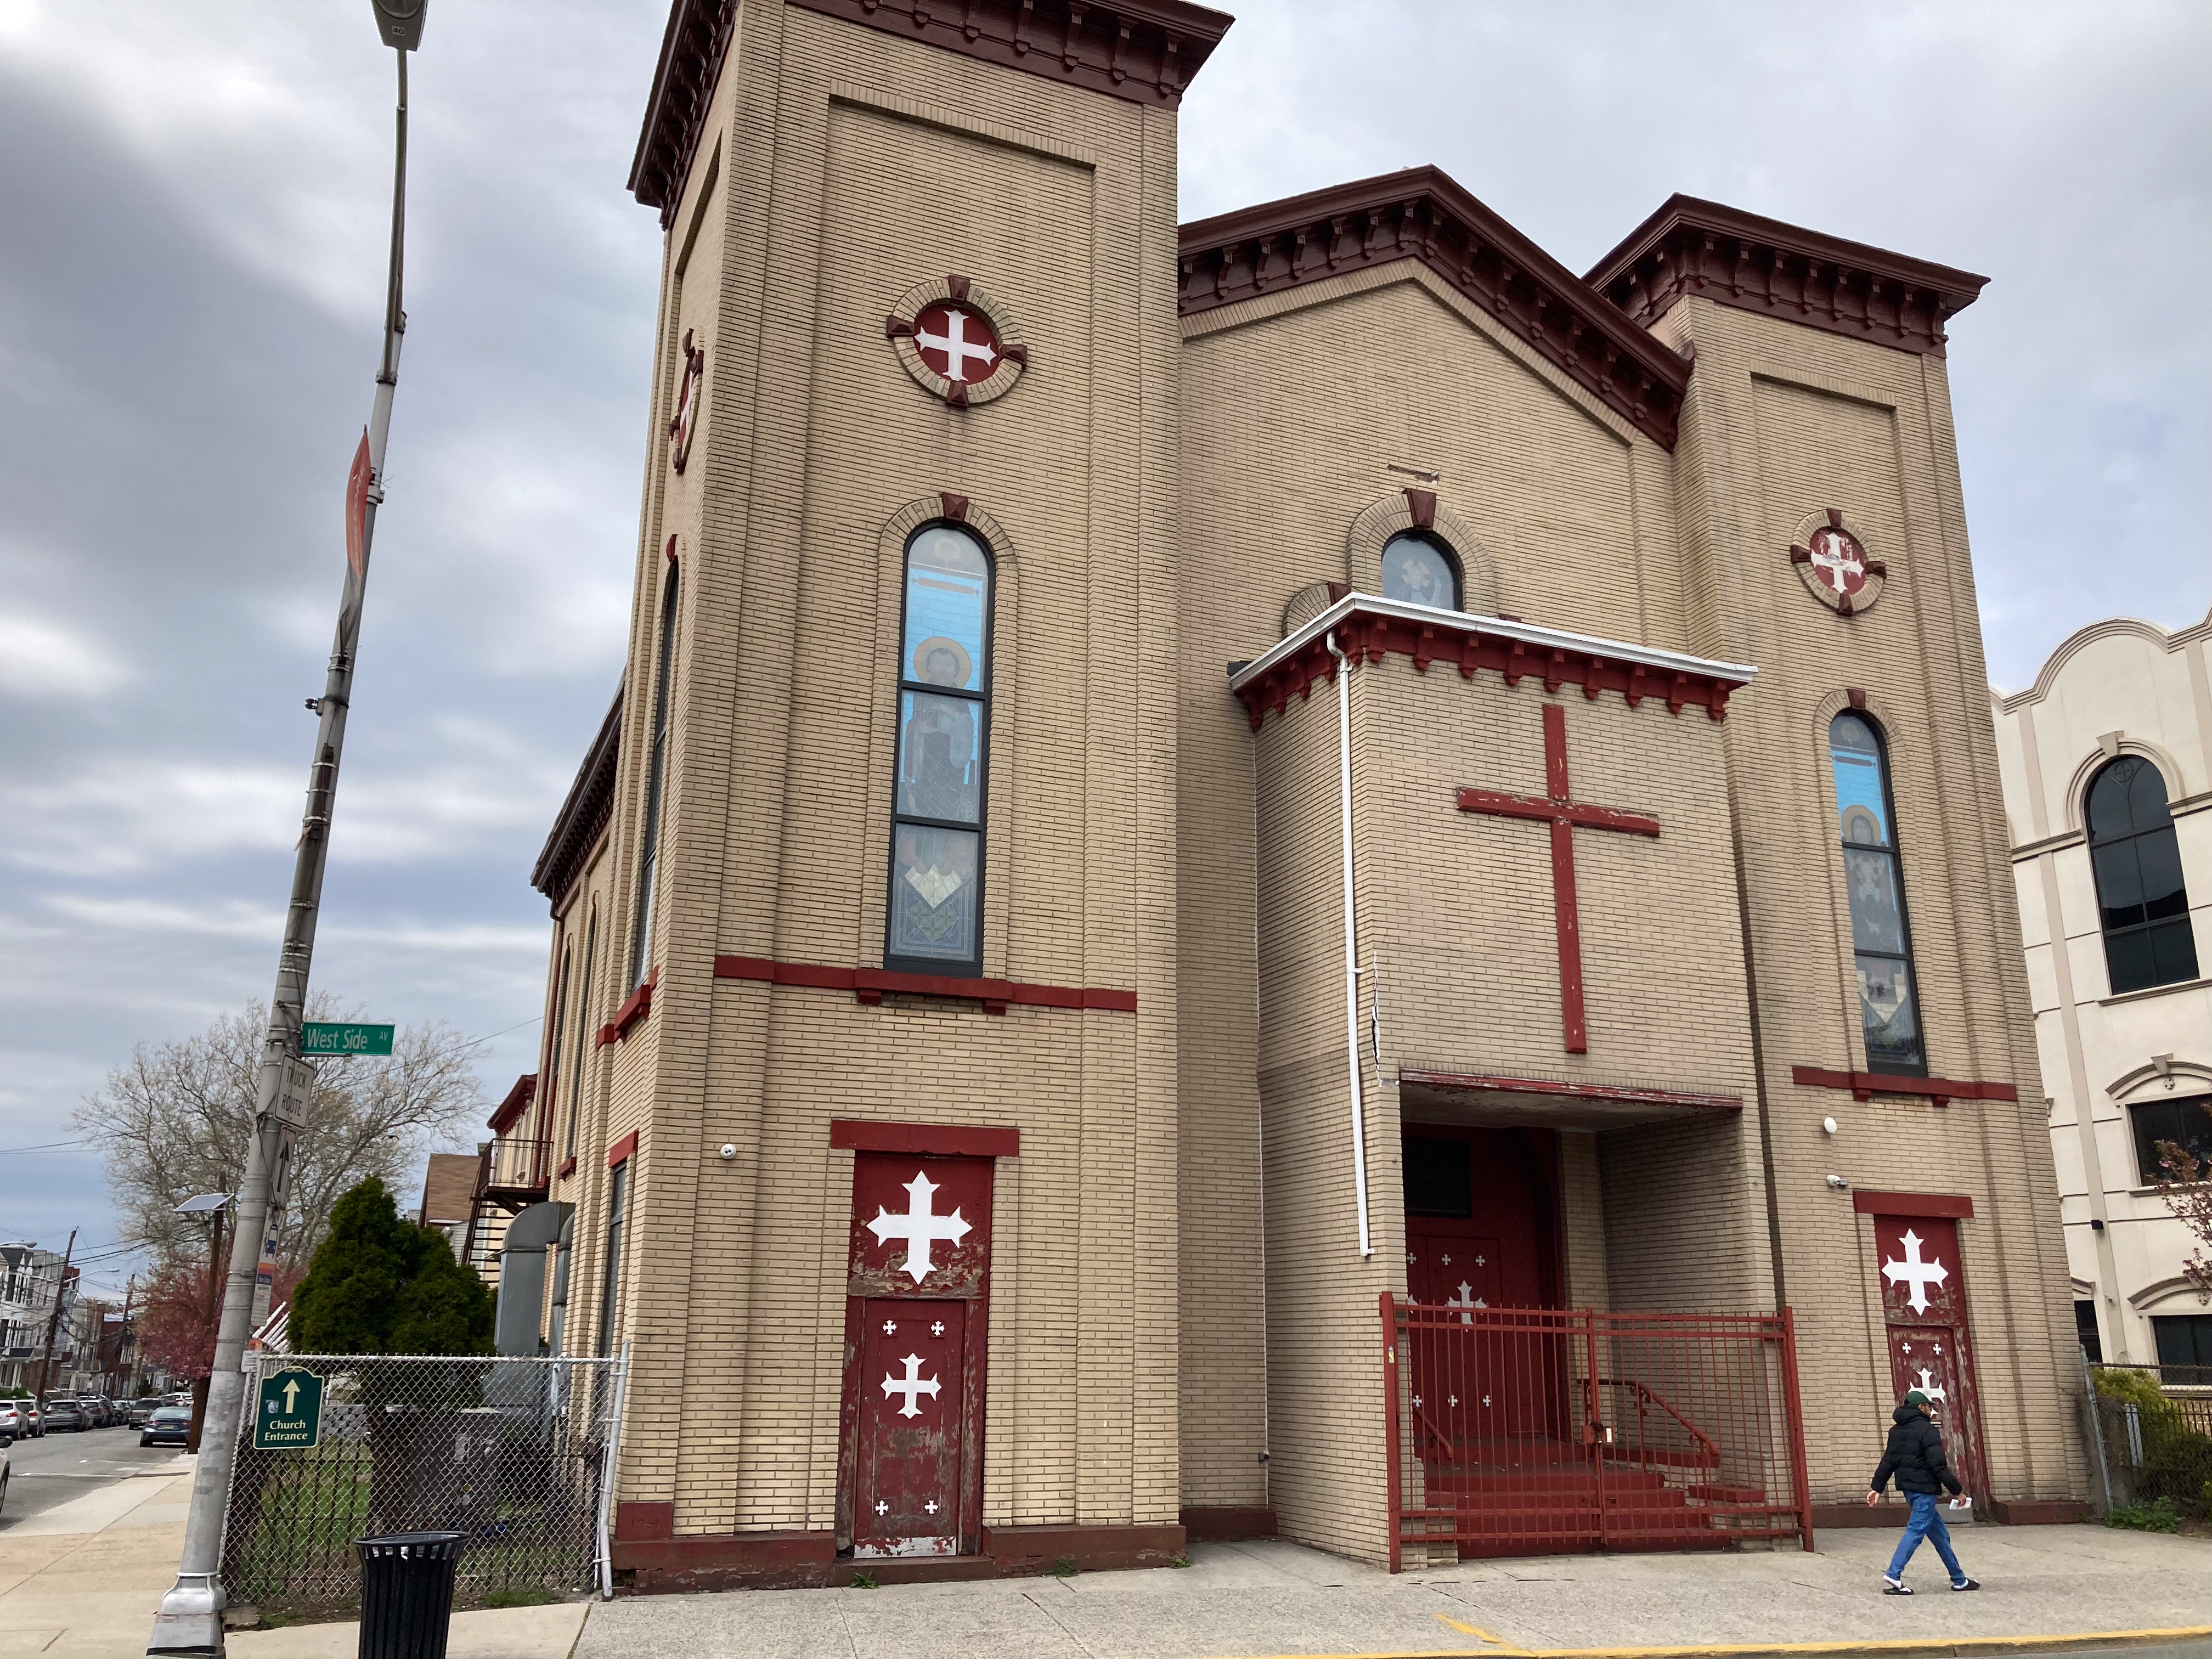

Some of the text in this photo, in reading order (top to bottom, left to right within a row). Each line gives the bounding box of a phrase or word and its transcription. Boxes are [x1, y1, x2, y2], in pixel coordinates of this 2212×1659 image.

[307, 1028, 389, 1049] West Side AV
[286, 1066, 307, 1090] TRUCK
[281, 1093, 303, 1116] ROUTE
[269, 1419, 306, 1430] Church
[264, 1432, 308, 1441] Entrance
